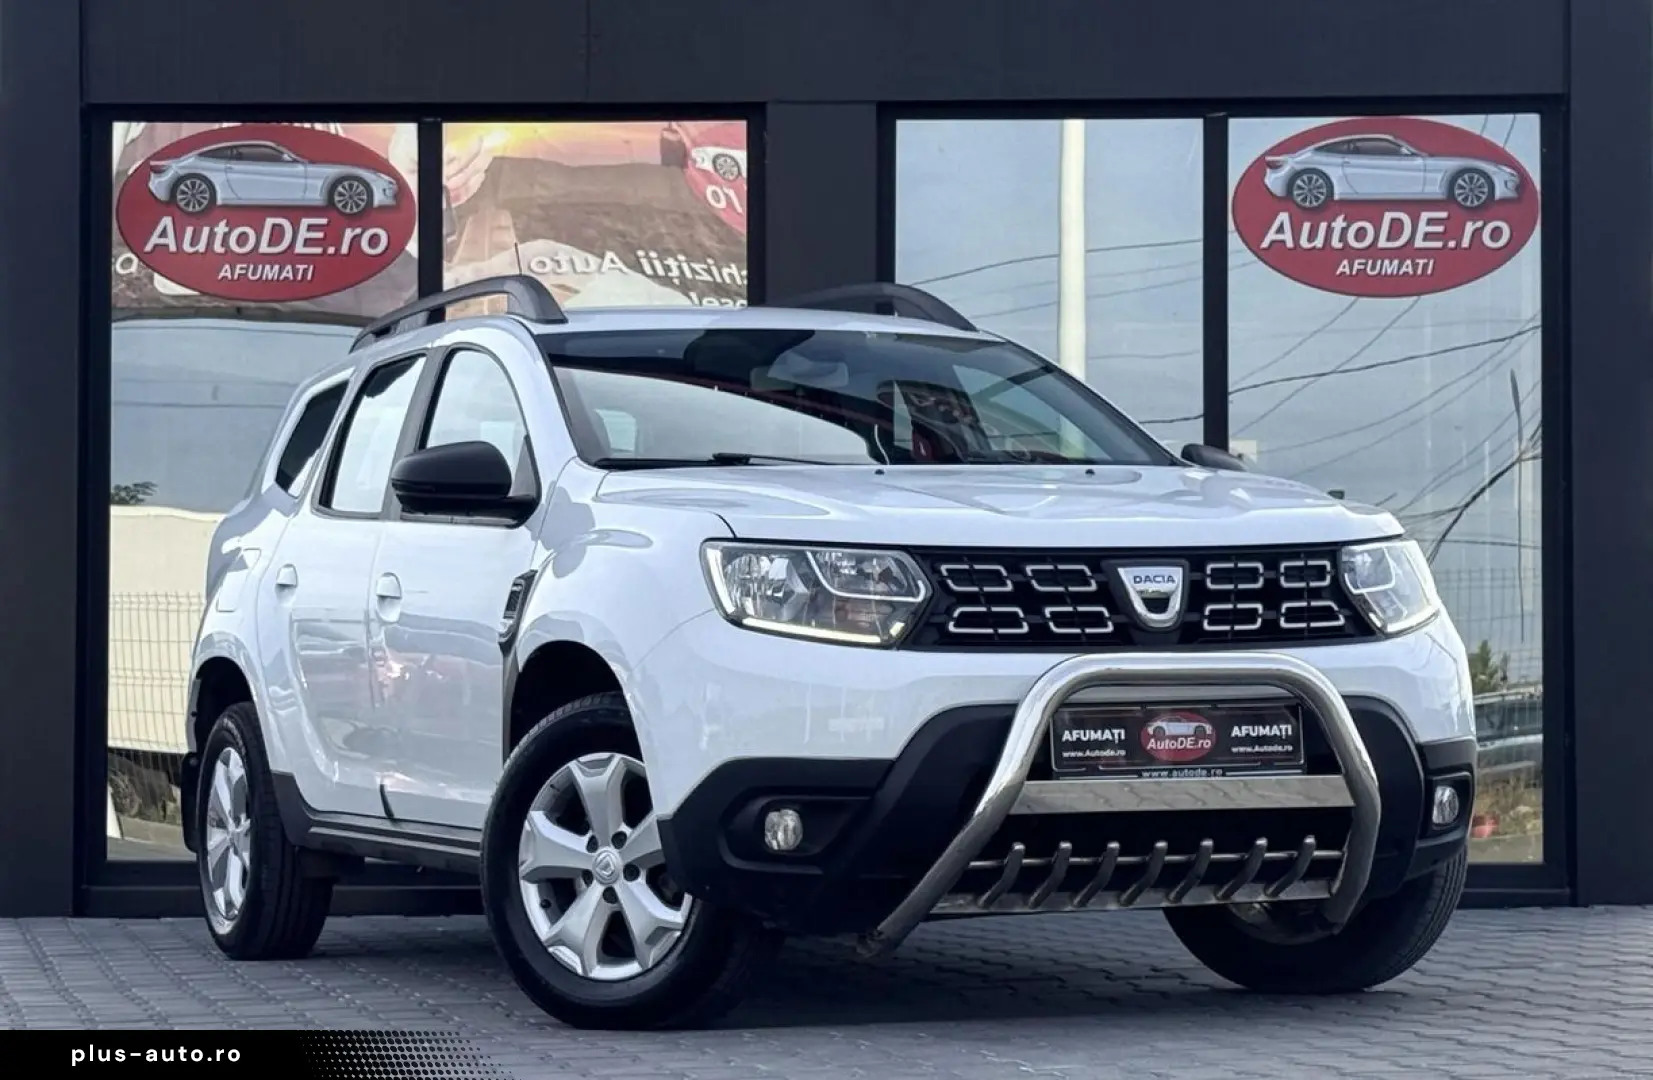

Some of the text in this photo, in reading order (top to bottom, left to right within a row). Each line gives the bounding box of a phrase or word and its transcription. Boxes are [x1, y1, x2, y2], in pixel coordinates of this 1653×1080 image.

[143, 215, 389, 256] AutoDE.ro
[1260, 210, 1512, 250] AutoDE.ro
[217, 263, 314, 281] AFUMATI
[1335, 258, 1435, 276] AFUMATI
[1133, 575, 1176, 585] DACIA
[1146, 736, 1212, 751] AutoDE.ro
[1141, 767, 1223, 778] www.autode.ro
